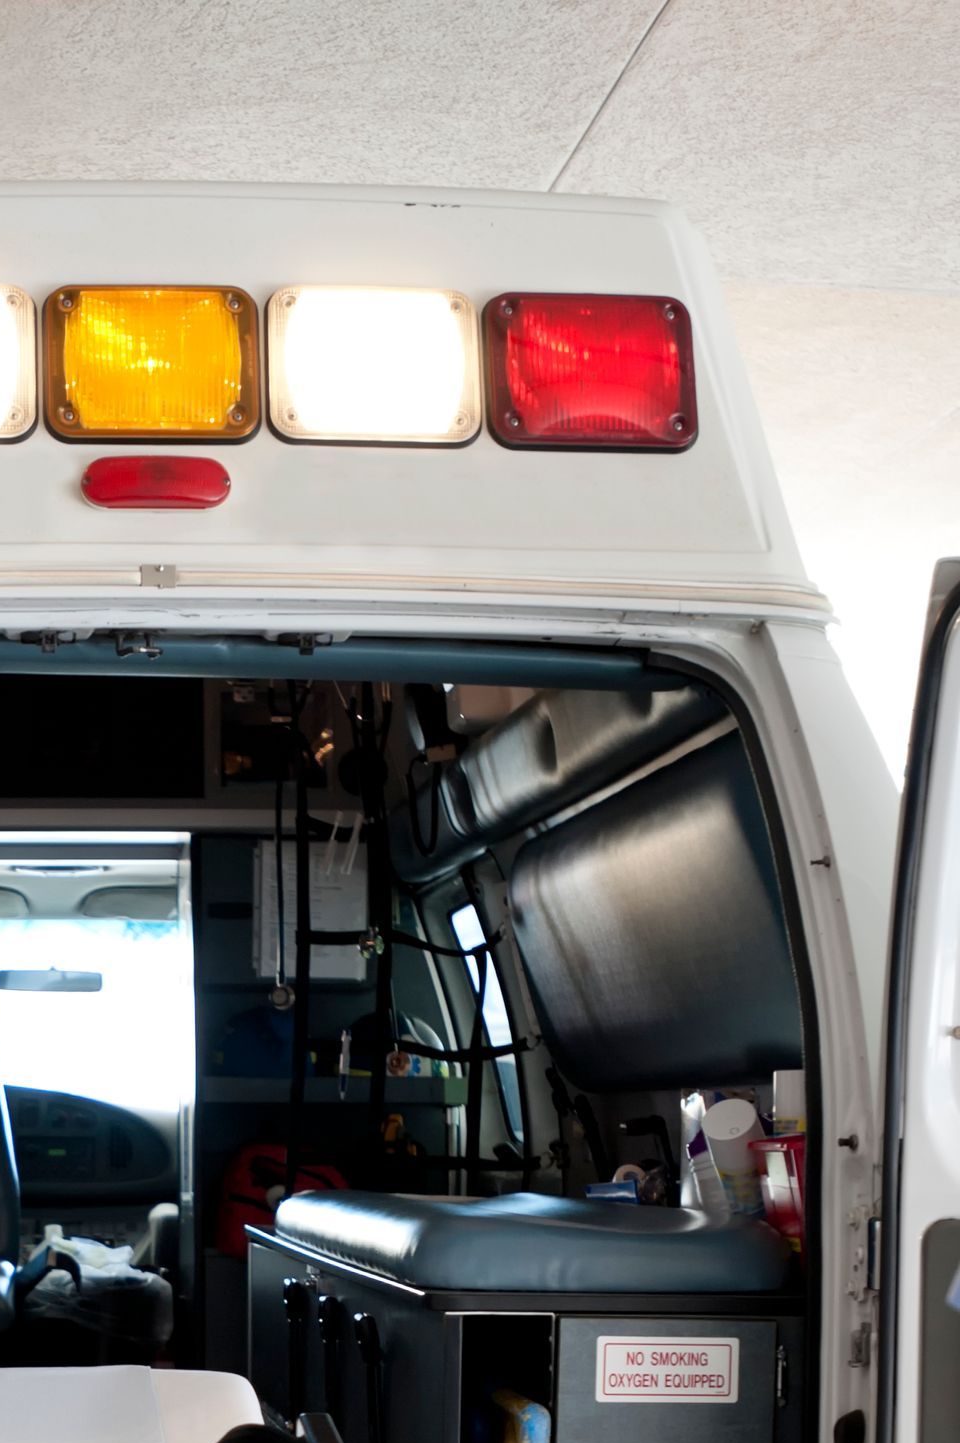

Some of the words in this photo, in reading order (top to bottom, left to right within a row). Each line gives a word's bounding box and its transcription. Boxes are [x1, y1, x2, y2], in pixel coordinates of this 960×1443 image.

[626, 1352, 644, 1366] NO
[650, 1352, 709, 1366] SMOKING
[608, 1373, 658, 1388] OXYGEN
[664, 1374, 725, 1389] EQUIPPED
